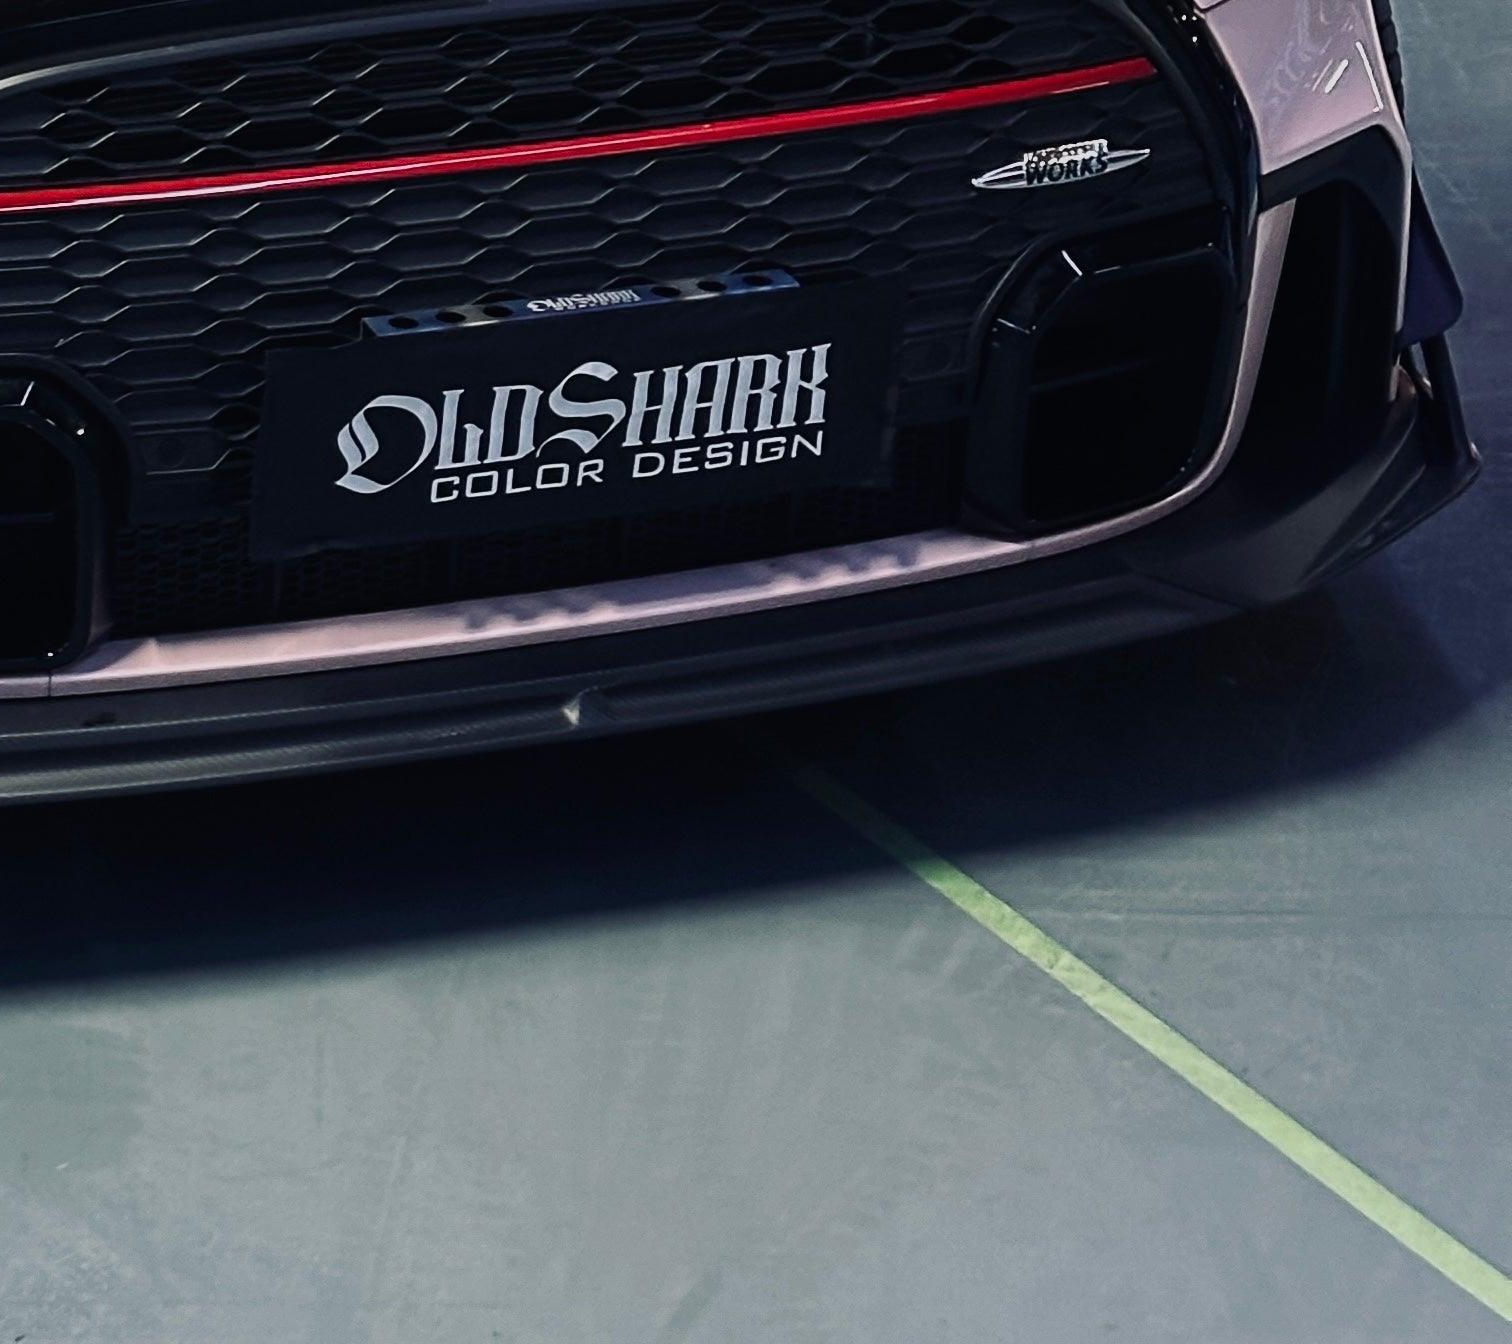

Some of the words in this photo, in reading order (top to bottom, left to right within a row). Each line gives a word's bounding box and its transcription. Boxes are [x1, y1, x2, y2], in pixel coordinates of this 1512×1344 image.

[1024, 153, 1109, 186] WORKS
[429, 458, 605, 503] COLOR
[632, 430, 824, 479] DESIGN
